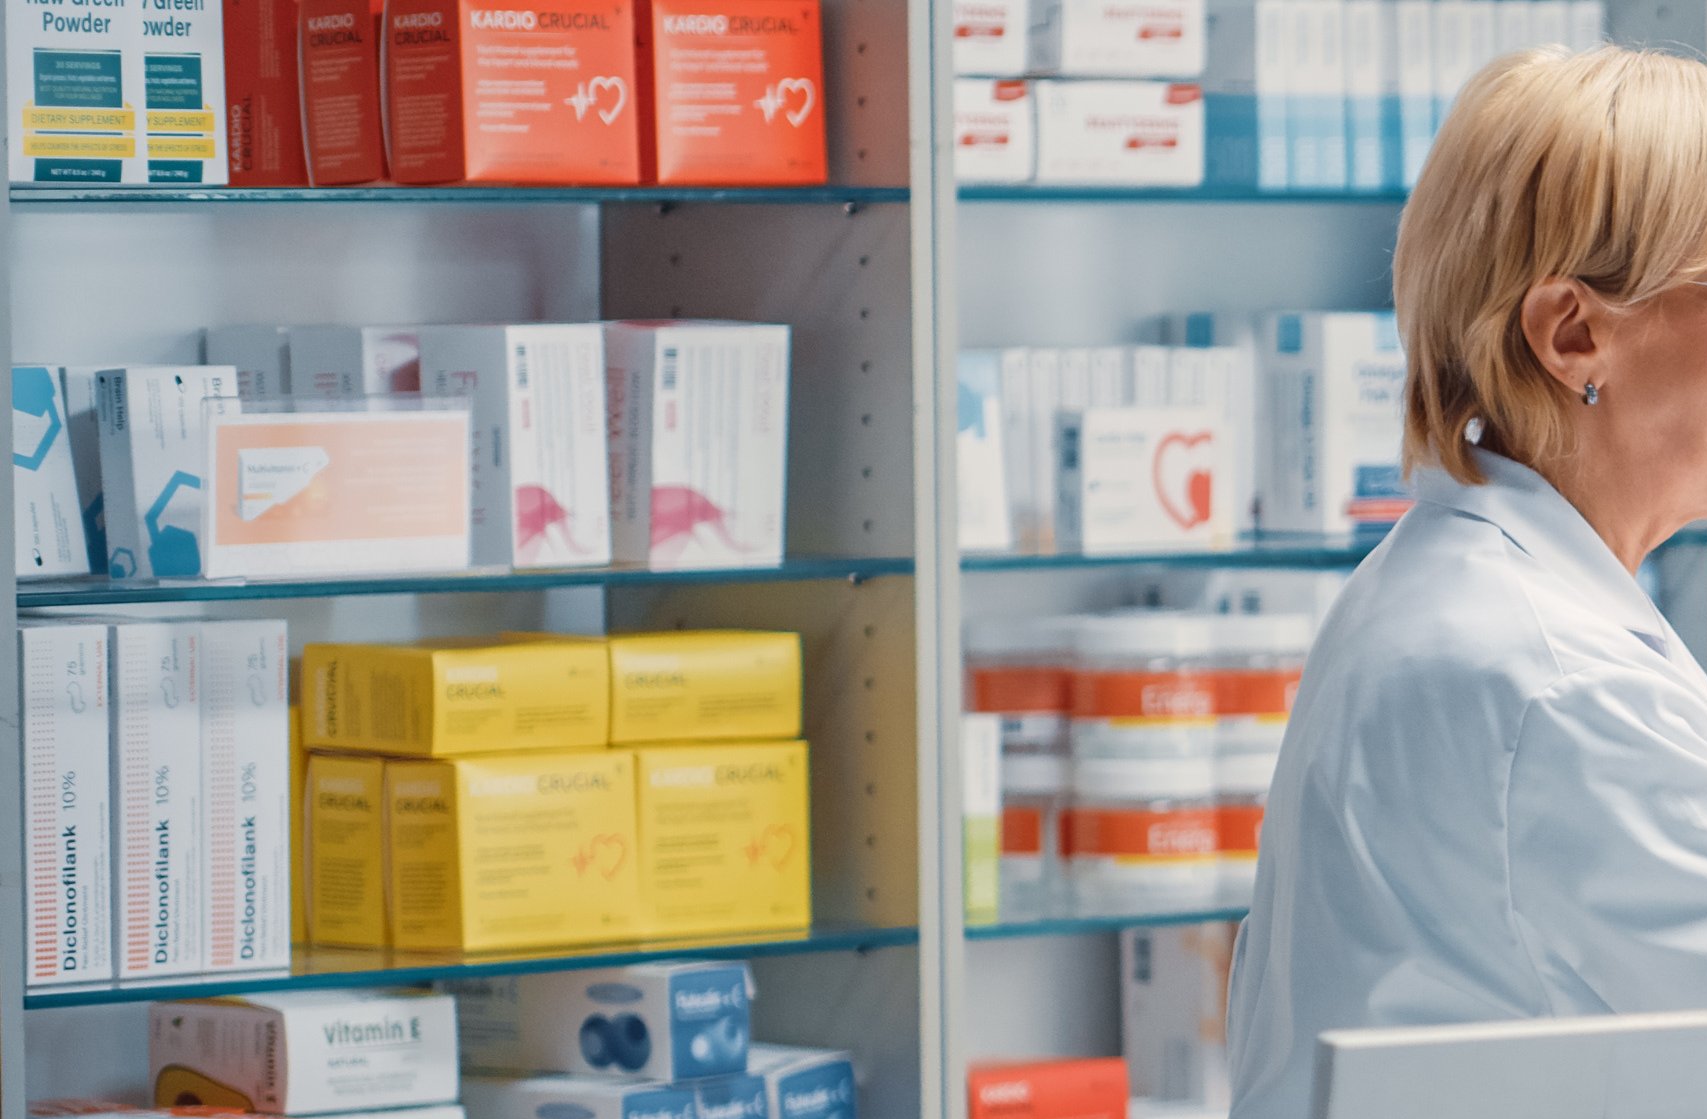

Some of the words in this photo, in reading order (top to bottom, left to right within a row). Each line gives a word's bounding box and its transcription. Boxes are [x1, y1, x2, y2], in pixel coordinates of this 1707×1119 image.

[43, 12, 111, 33] Powder
[308, 13, 355, 30] KARDIO
[394, 12, 443, 29] KARDIO
[470, 10, 535, 30] KARDIO
[537, 12, 610, 30] CRUCIAL
[662, 15, 727, 34] KARDIO
[729, 16, 799, 34] CRUCIAL
[310, 30, 362, 47] CRUCIAL
[395, 29, 450, 45] CRUCIAL
[65, 61, 101, 70] SERVINGS
[31, 113, 67, 124] DIETARY
[69, 114, 126, 126] SUPPLEMENT
[152, 116, 206, 127] SUPPLEMENT
[232, 104, 242, 172] KARDIO
[113, 376, 123, 403] Brain
[116, 406, 125, 431] Help
[66, 660, 78, 677] 75
[160, 655, 171, 672] 75
[625, 672, 686, 688] CRUCIAL
[326, 659, 338, 738] CRUCIAL
[446, 682, 506, 698] CRUCIAL
[155, 764, 170, 804] 10%
[240, 762, 257, 802] 10%
[538, 774, 611, 793] CRUCIAL
[715, 766, 784, 783] CRUCIAL
[62, 770, 77, 812] 10%
[319, 793, 372, 812] CRUCIAL
[396, 798, 449, 814] CRUCIAL
[154, 819, 170, 964] Diclonofilank
[240, 815, 256, 961] Diclonofilank
[62, 825, 77, 972] Diclonofilank
[323, 1015, 404, 1044] Vitamin
[410, 1016, 420, 1039] E
